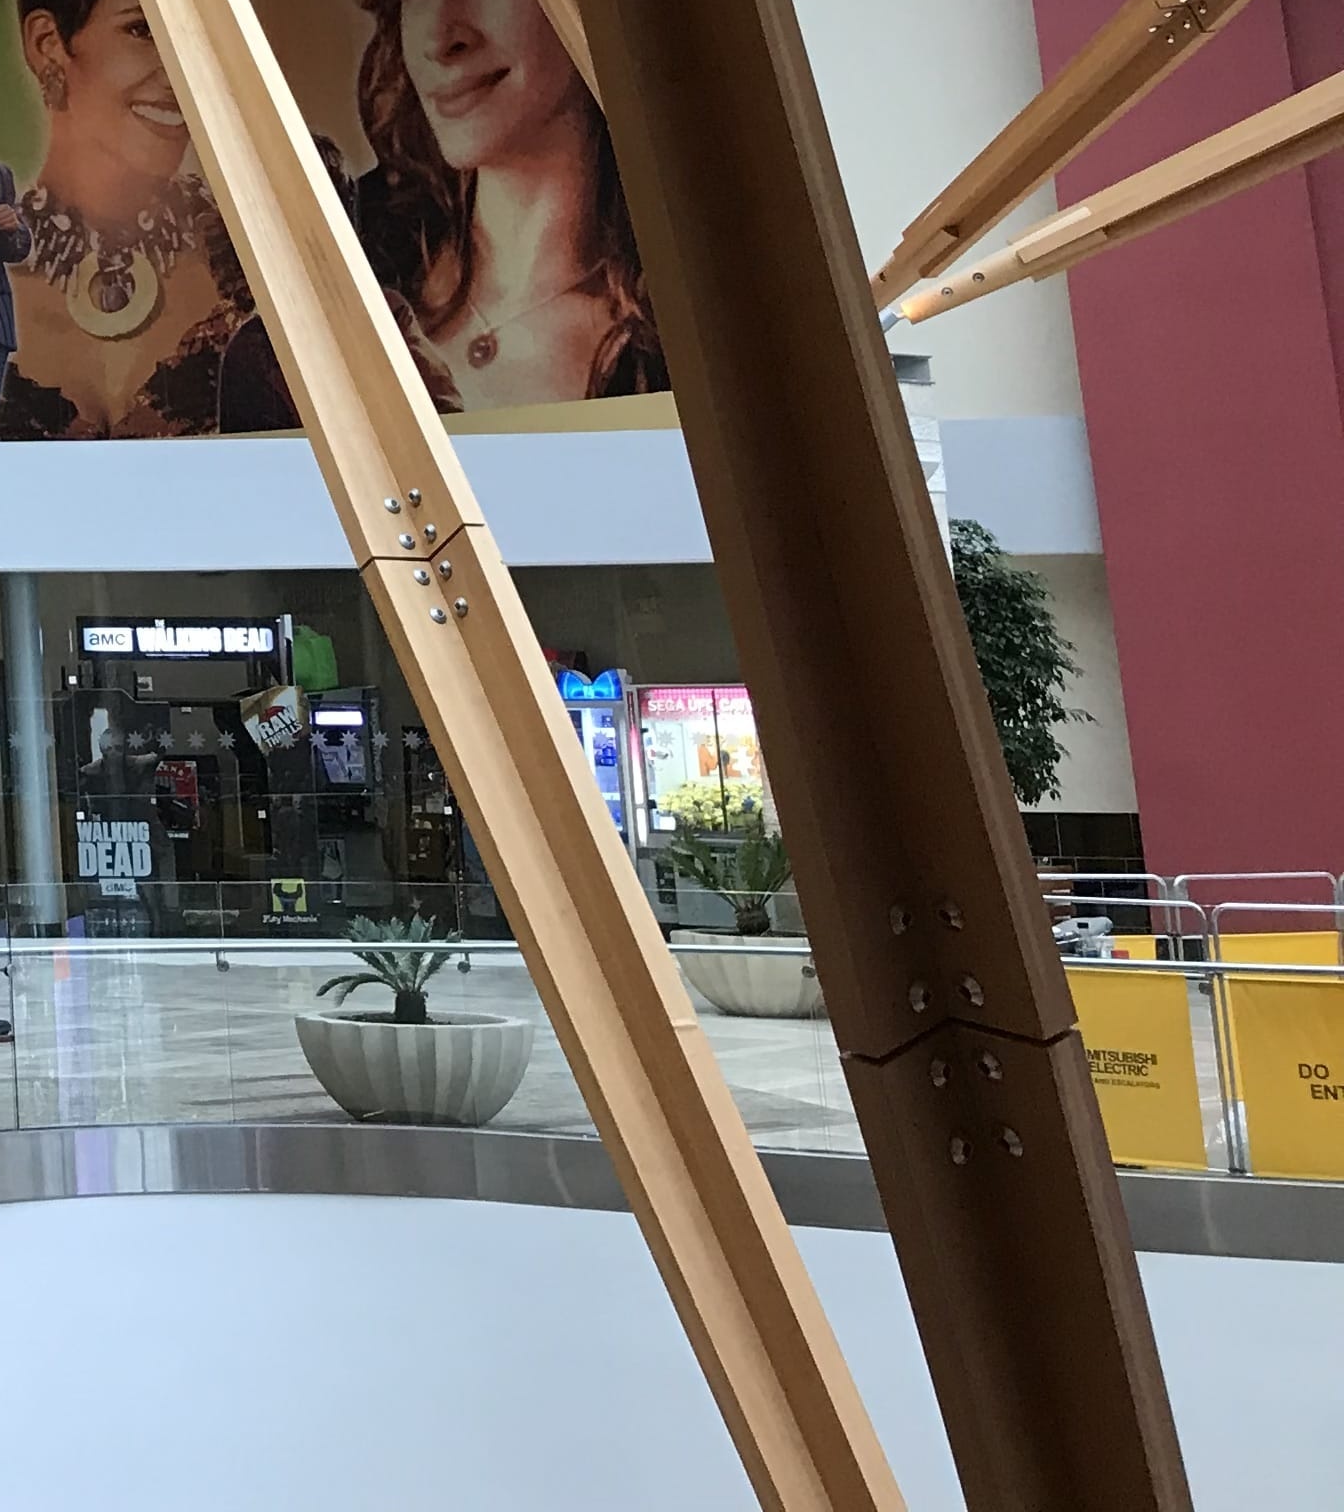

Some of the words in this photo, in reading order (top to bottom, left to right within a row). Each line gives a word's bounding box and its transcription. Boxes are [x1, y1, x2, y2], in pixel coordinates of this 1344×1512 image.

[224, 627, 274, 652] DEAD
[76, 821, 150, 842] WALKING
[77, 842, 152, 877] DEAD
[1087, 1048, 1158, 1066] MITSUBISHI
[1088, 1061, 1149, 1077] ELECTRIC
[1298, 1063, 1330, 1080] DO
